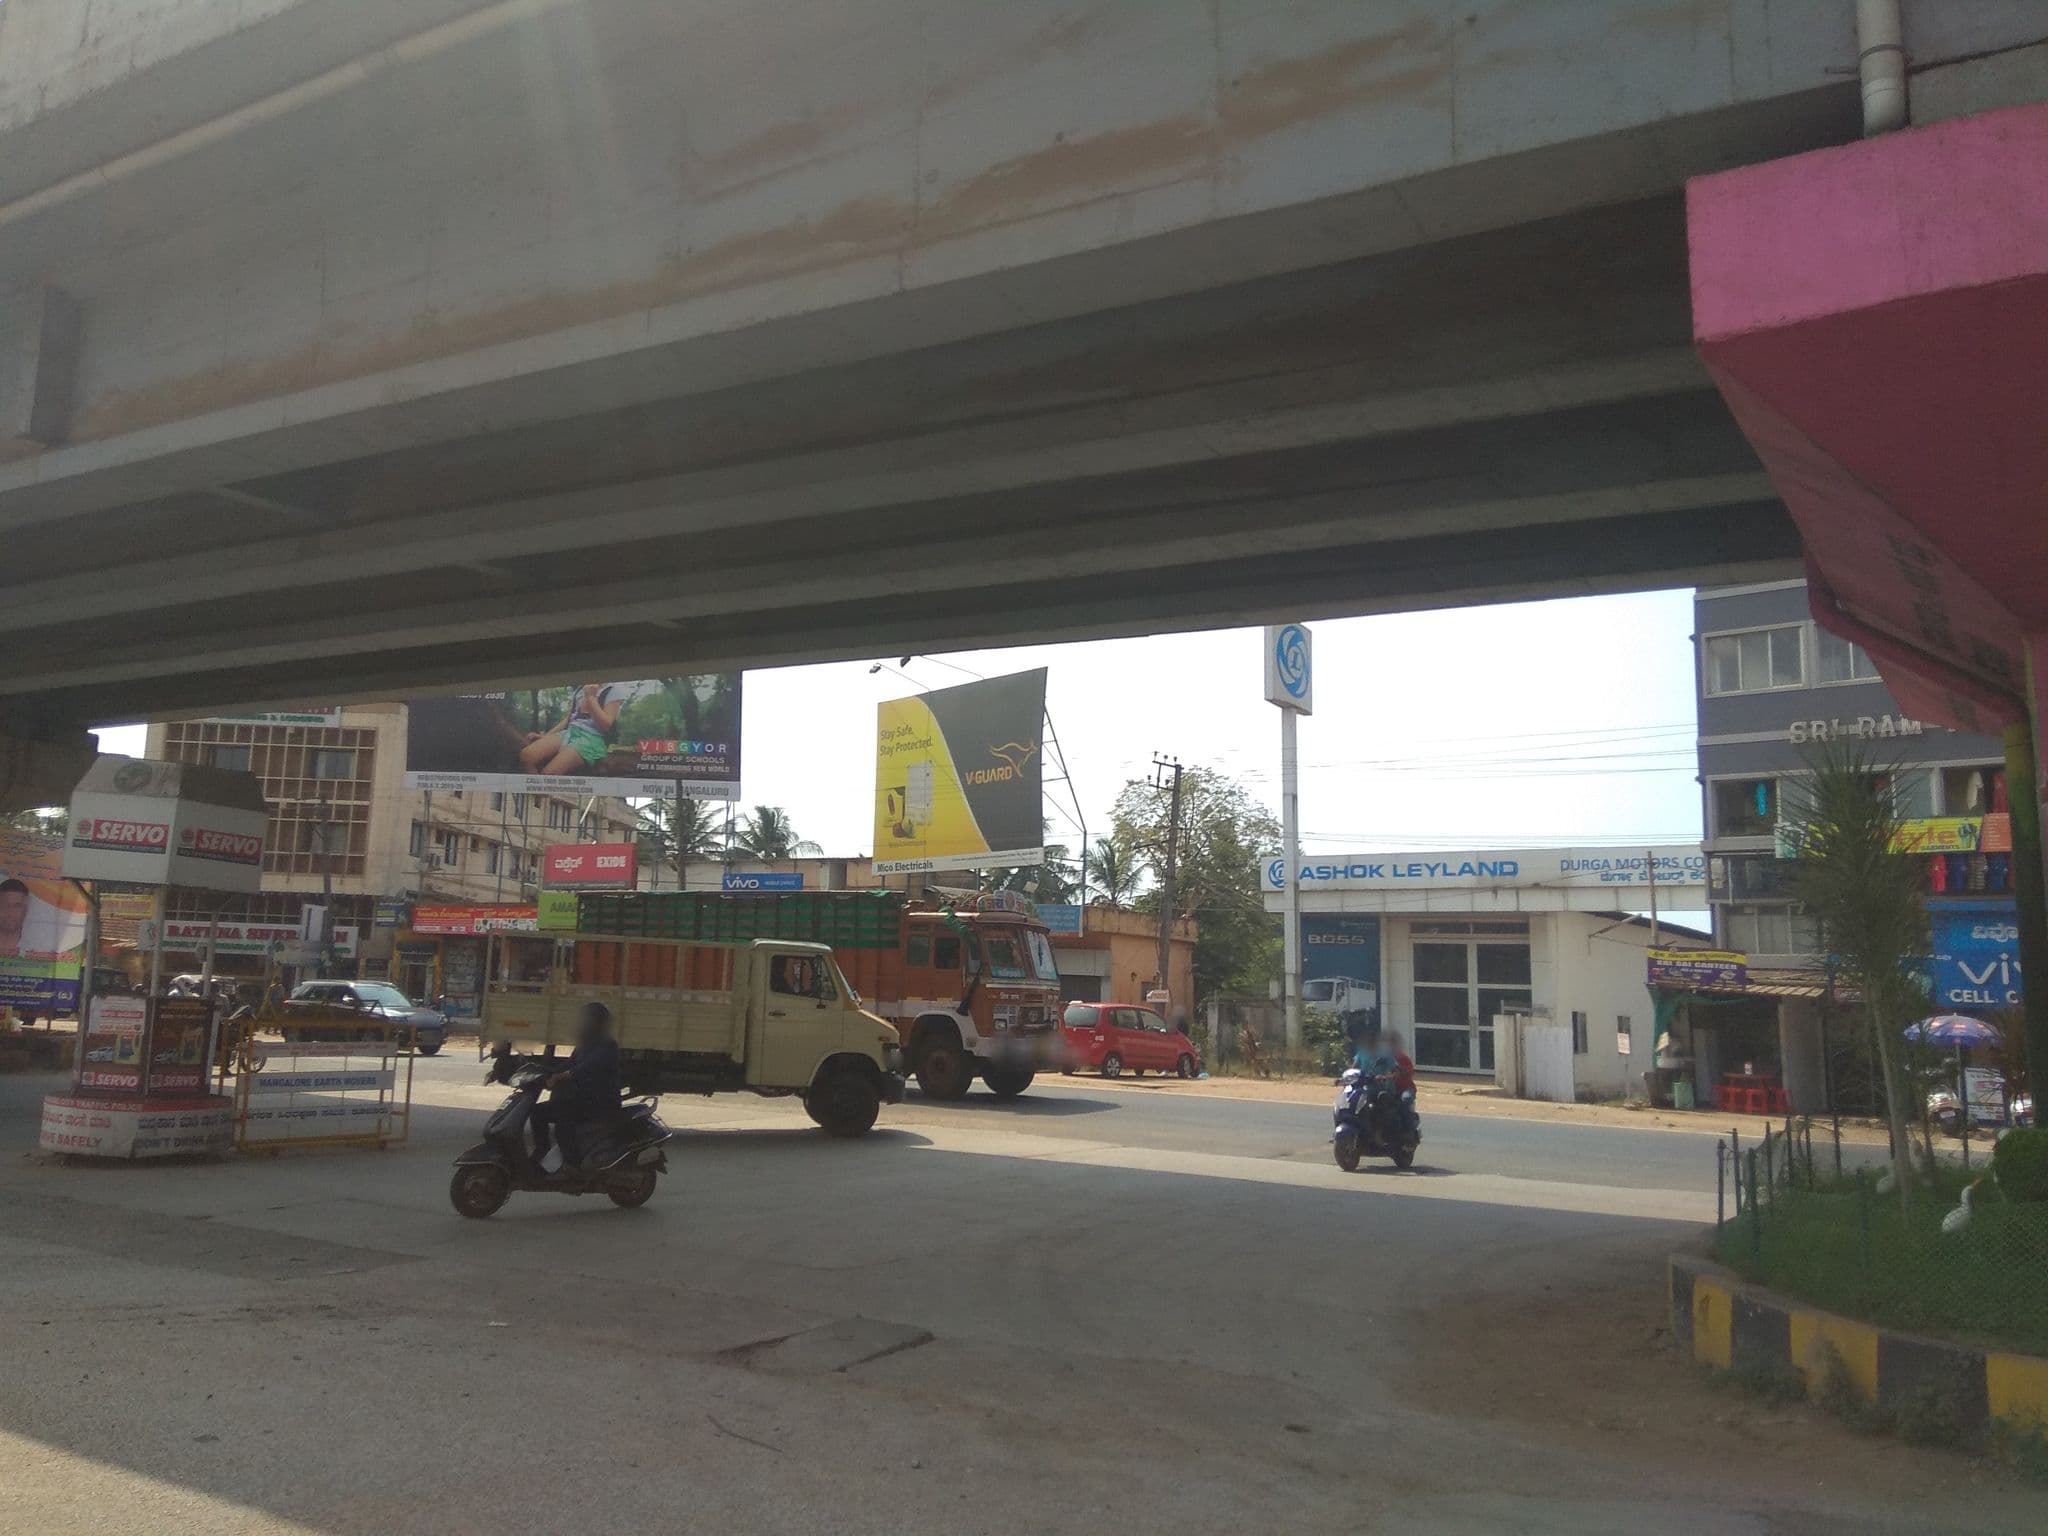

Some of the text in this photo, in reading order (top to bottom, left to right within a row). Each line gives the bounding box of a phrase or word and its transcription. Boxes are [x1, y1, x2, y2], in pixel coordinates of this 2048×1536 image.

[880, 724, 914, 742] Stay Safe.
[1790, 719, 1840, 744] SRI
[639, 741, 727, 753] VIBGYOR
[880, 737, 933, 757] Stay Protected.
[640, 754, 671, 762] GROUP
[685, 756, 725, 764] SCHOOLS
[964, 766, 1013, 785] V-GUARD
[642, 784, 663, 794] NOW
[680, 785, 730, 796] ANGALURU
[96, 821, 166, 843] SERVO
[199, 831, 258, 855] SERVO
[596, 855, 628, 868] EXIDE
[877, 859, 934, 873] Mico Electricals
[1560, 859, 1611, 871] DURGA
[1615, 857, 1680, 870] MOTORS
[1299, 860, 1520, 880] ASHOK LEYLAND
[726, 876, 759, 888] vivo
[1308, 934, 1366, 945] BOSS
[96, 1073, 139, 1088] SERVO
[162, 1074, 200, 1087] SERVO
[260, 1076, 377, 1088] MANGALORE EARTH MOVERS
[57, 1133, 103, 1147] SAFELY
